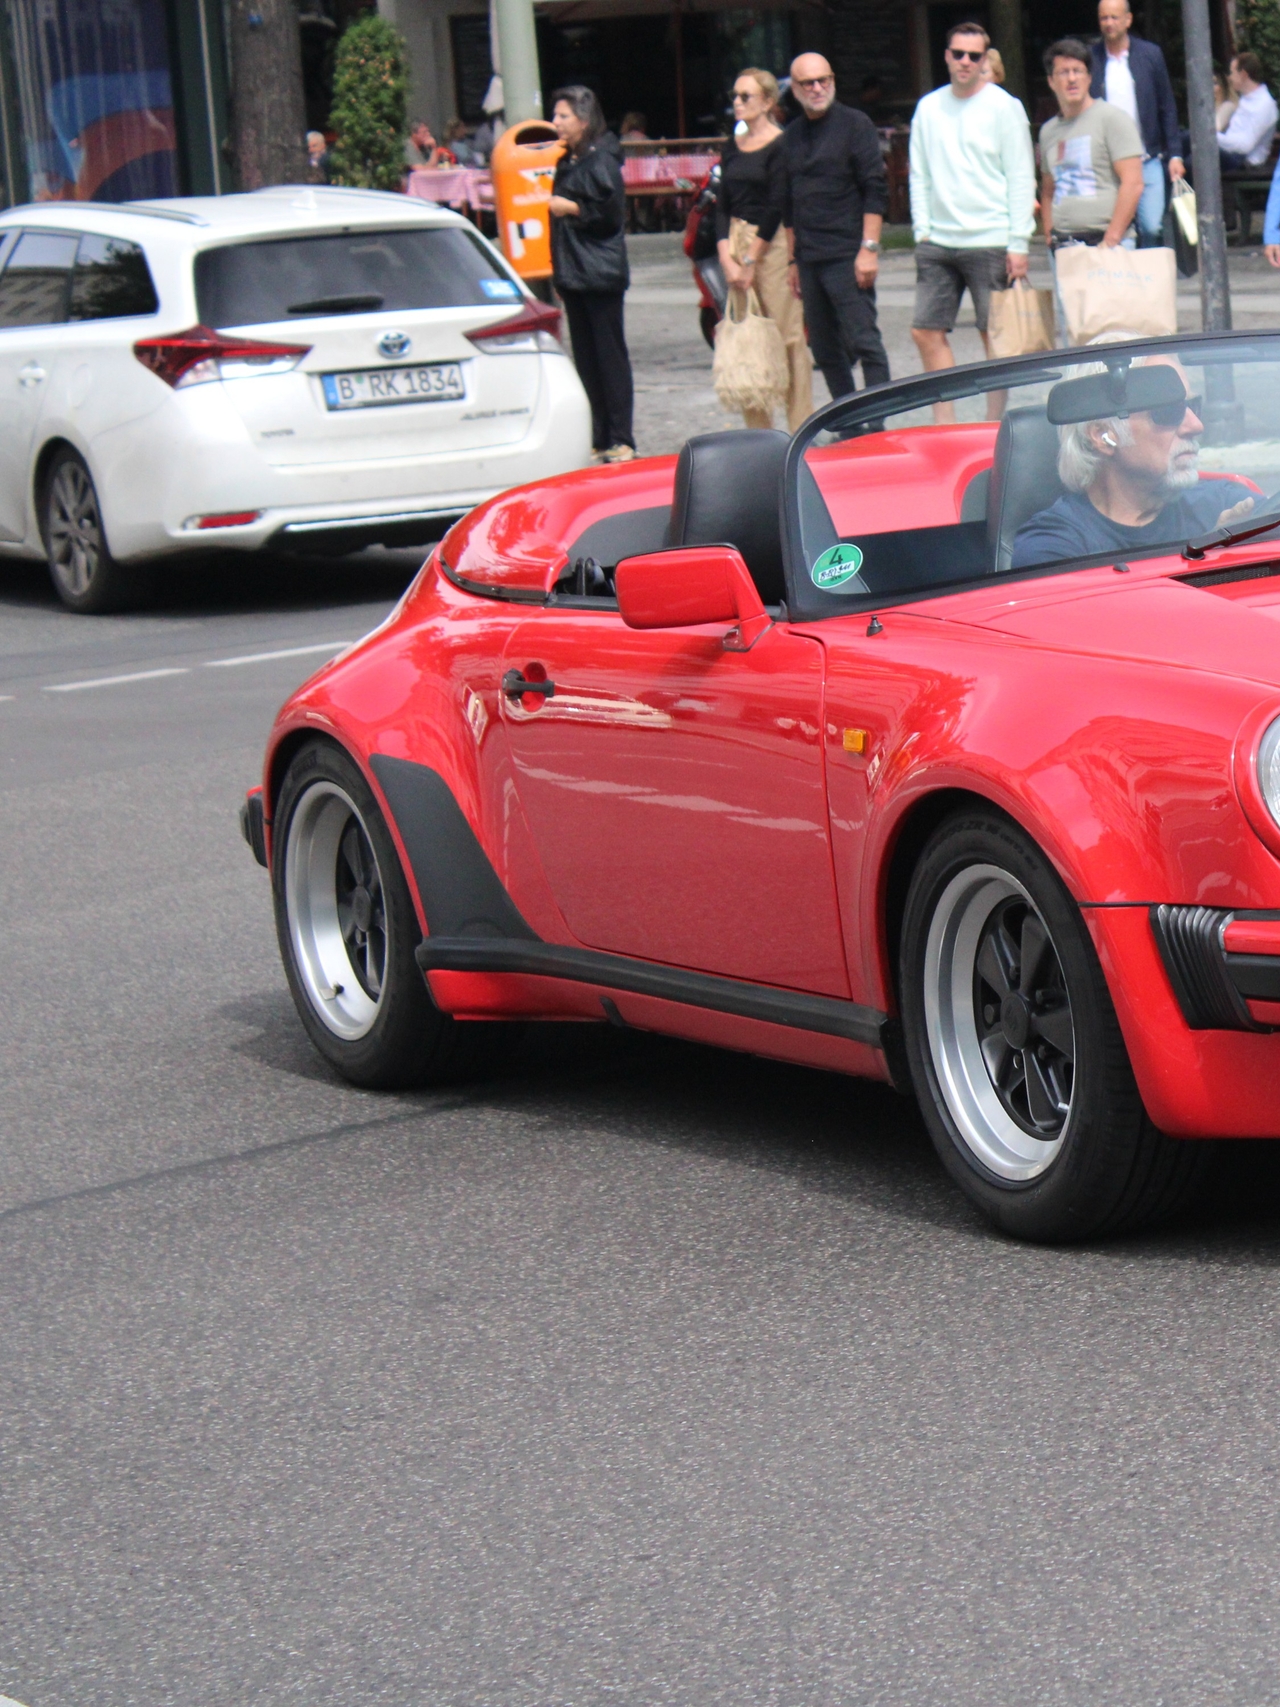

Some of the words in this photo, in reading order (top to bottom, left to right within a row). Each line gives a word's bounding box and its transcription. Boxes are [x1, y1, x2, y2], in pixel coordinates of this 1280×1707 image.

[338, 377, 354, 400] B
[368, 372, 400, 397] RK
[403, 368, 459, 394] 1834
[829, 547, 844, 565] 4
